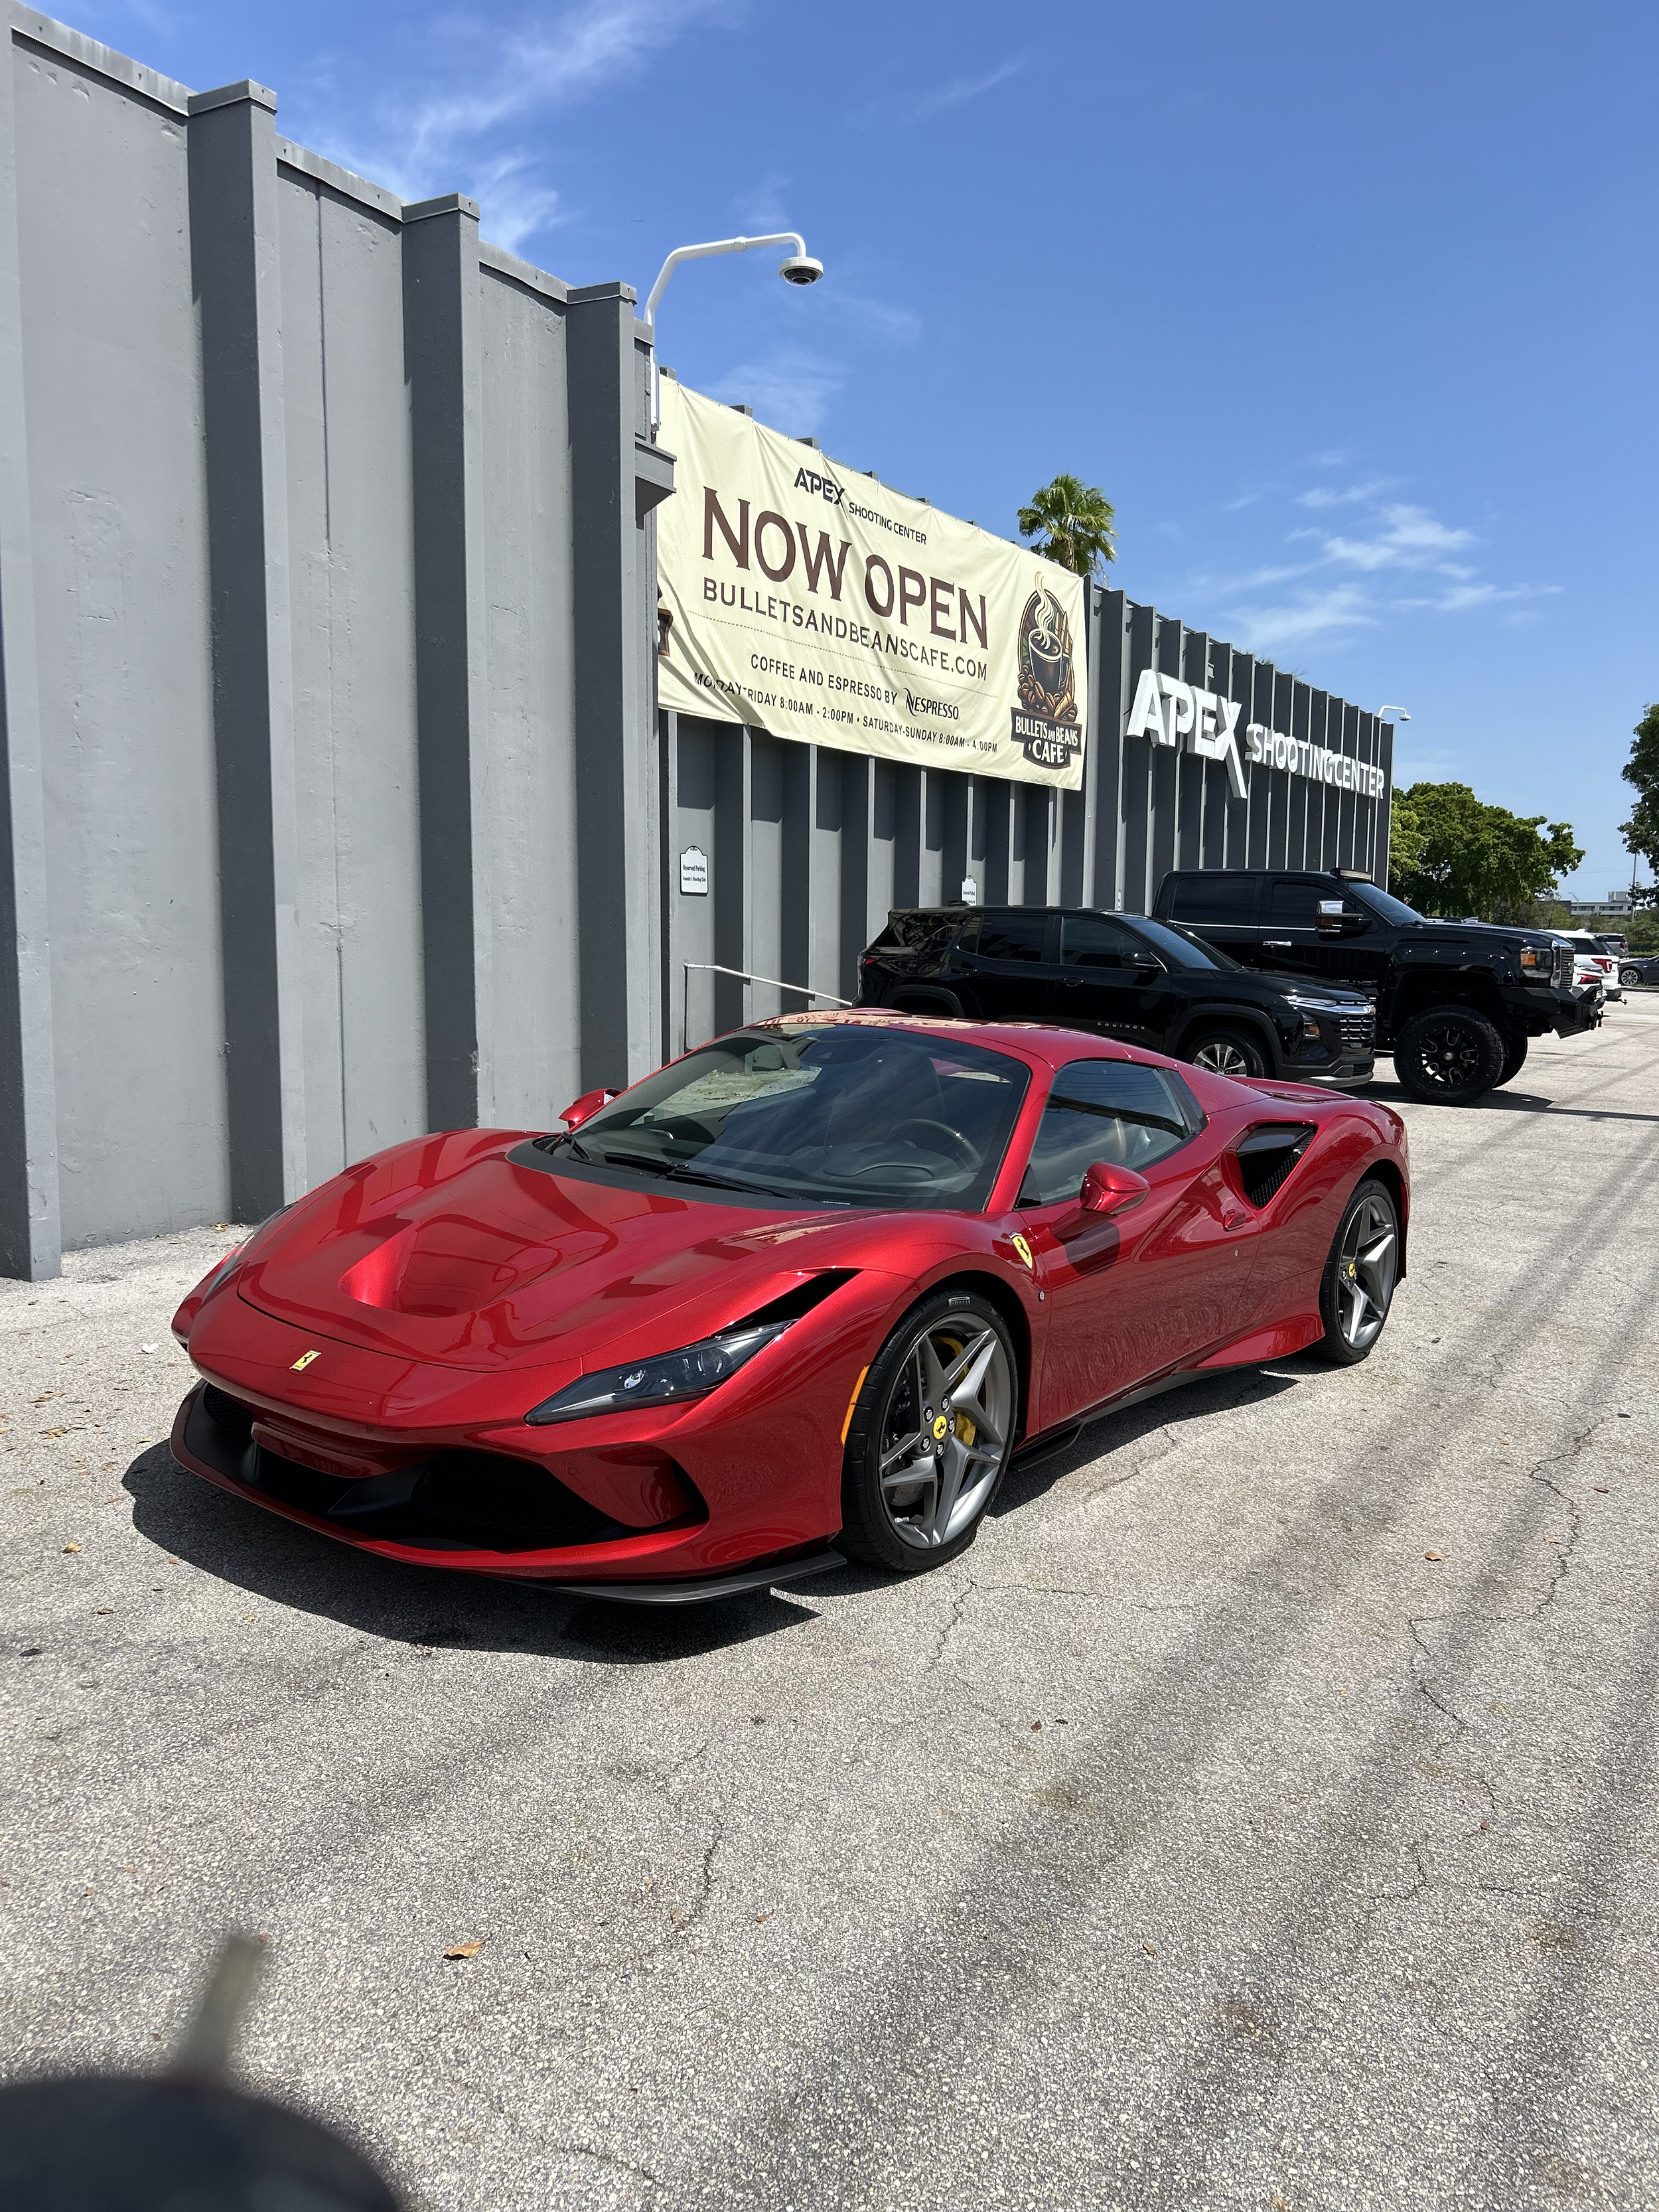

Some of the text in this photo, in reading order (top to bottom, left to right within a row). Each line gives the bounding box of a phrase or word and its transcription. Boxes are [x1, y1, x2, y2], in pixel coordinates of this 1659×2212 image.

[794, 467, 926, 545] APEX SHOOTING CENTER
[702, 486, 988, 650] NOW OPEN
[703, 577, 987, 681] BULLETSANDBEANSCAFE.COM
[751, 654, 959, 720] COFFEE AND ESPRESSO BY NESPRESSO
[780, 698, 813, 715] 8:00AM
[822, 707, 853, 724] 2:00PM
[863, 715, 937, 743] SATURDAY-SUNDAY
[939, 733, 965, 748] 8:00AM
[972, 739, 997, 753] 4:00PM
[1015, 715, 1048, 740] BULLETS
[1056, 726, 1078, 747] BEANS
[1032, 739, 1064, 763] CAFE
[1126, 668, 1248, 799] APEX
[1097, 1021, 1145, 1030] EQUINOX
